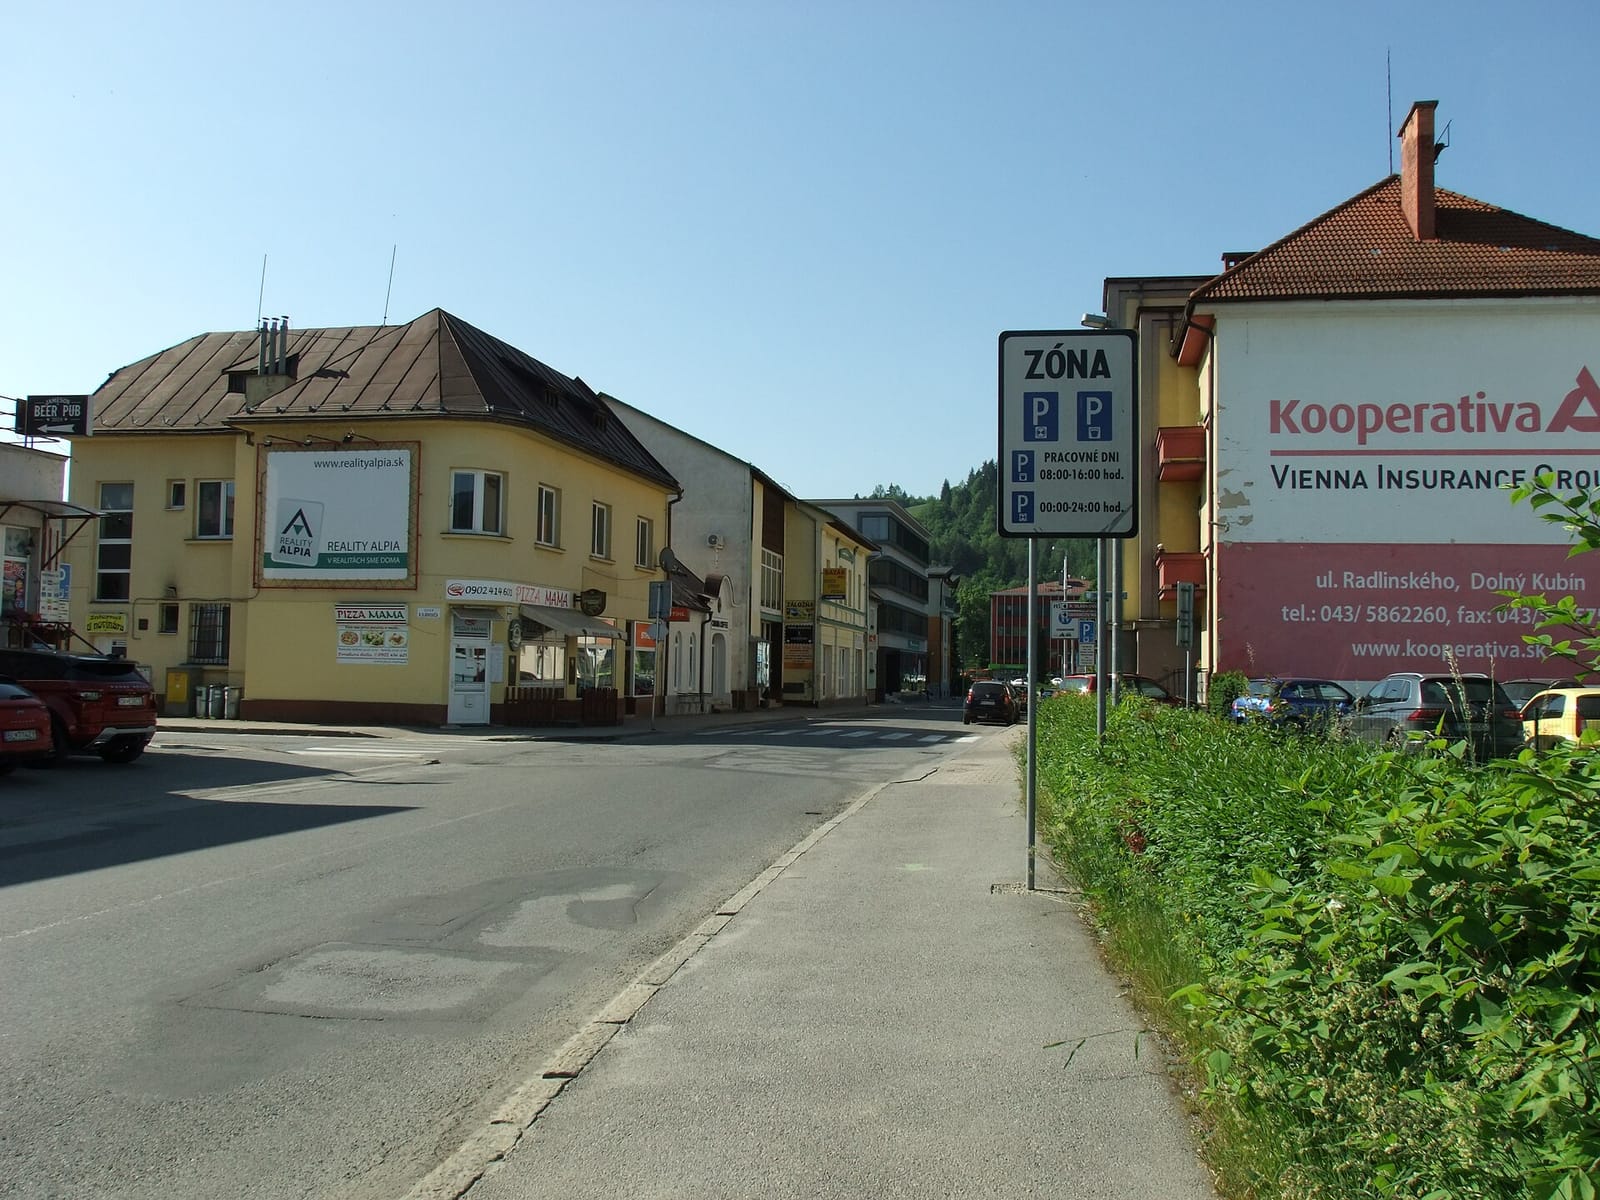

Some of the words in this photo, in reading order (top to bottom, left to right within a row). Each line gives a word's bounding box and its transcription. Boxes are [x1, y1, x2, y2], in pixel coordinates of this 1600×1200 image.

[1024, 342, 1111, 380] ZÓNA
[34, 405, 58, 417] BEER
[62, 405, 81, 417] PUB
[1269, 391, 1541, 445] Kooperativa
[1044, 449, 1098, 463] PRACOVNÉ
[1101, 451, 1119, 463] DNI
[314, 457, 404, 470] www.realityalpia.sk
[1040, 469, 1100, 480] 08:00-16:00
[1103, 468, 1124, 480] hod.
[1040, 502, 1100, 513] 00:00-24:00
[1103, 501, 1124, 513] hod.
[280, 537, 313, 547] REALITY
[327, 541, 368, 551] REALITY
[371, 540, 400, 551] ALPIA
[279, 545, 311, 557] ALPIA
[1316, 570, 1338, 588] ul.
[1343, 571, 1460, 592] Radlinského,
[1471, 571, 1526, 592] Dolný
[1532, 572, 1586, 591] Kubín
[515, 586, 541, 604] PIZZA
[544, 589, 569, 608] MAMA
[337, 610, 366, 619] PIZZA
[368, 610, 405, 619] MAMA
[1281, 604, 1316, 622] tel.:
[1320, 605, 1361, 623] 043/
[1366, 606, 1451, 626] 5862260,
[1457, 606, 1492, 624] fax:
[1351, 639, 1547, 661] www.kooperativa.sk
